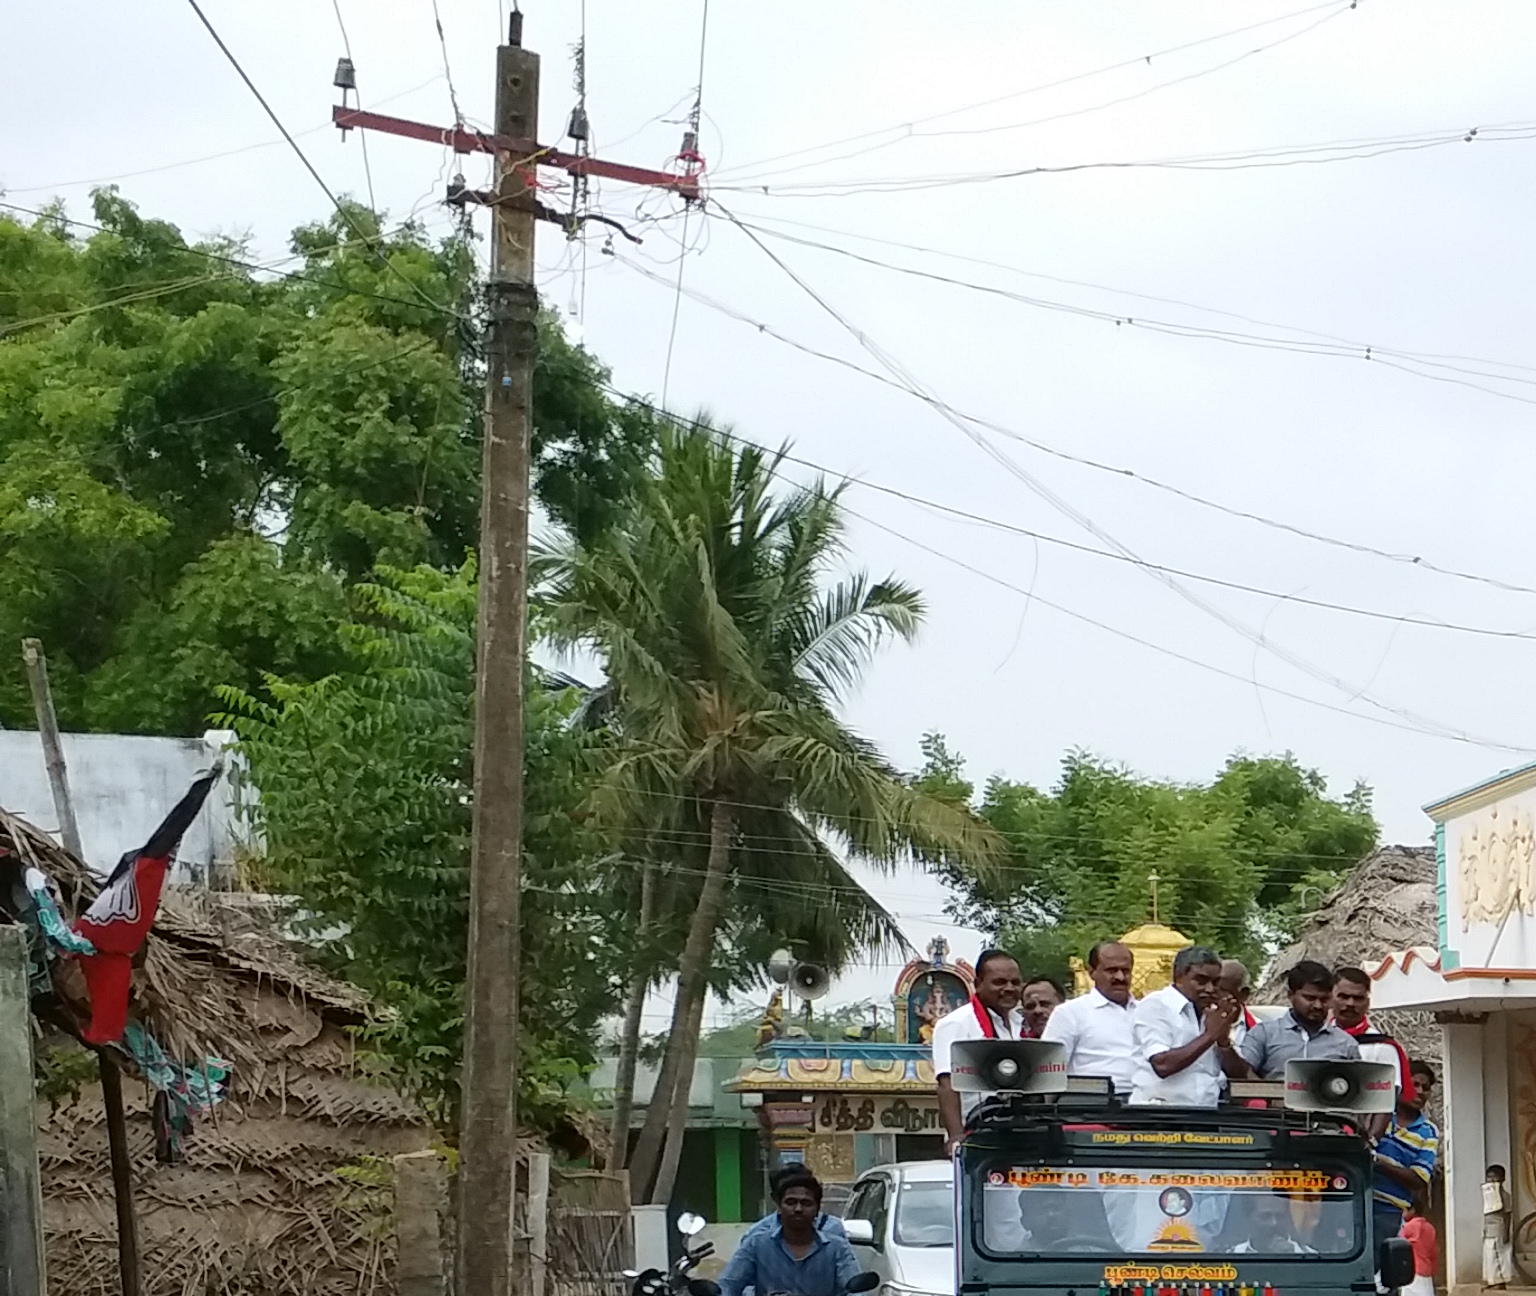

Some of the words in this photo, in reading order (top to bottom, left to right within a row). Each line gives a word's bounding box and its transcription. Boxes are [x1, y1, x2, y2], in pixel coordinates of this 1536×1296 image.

[881, 1098, 941, 1132] விநா
[1092, 1132, 1131, 1145] நமது
[1133, 1132, 1182, 1145] வெற்றி
[1184, 1132, 1254, 1145] வேட்பாளர்
[1009, 1169, 1088, 1187] பூண்டி
[1105, 1261, 1159, 1284] பூண்டி
[1162, 1262, 1237, 1281] செல்வம்
